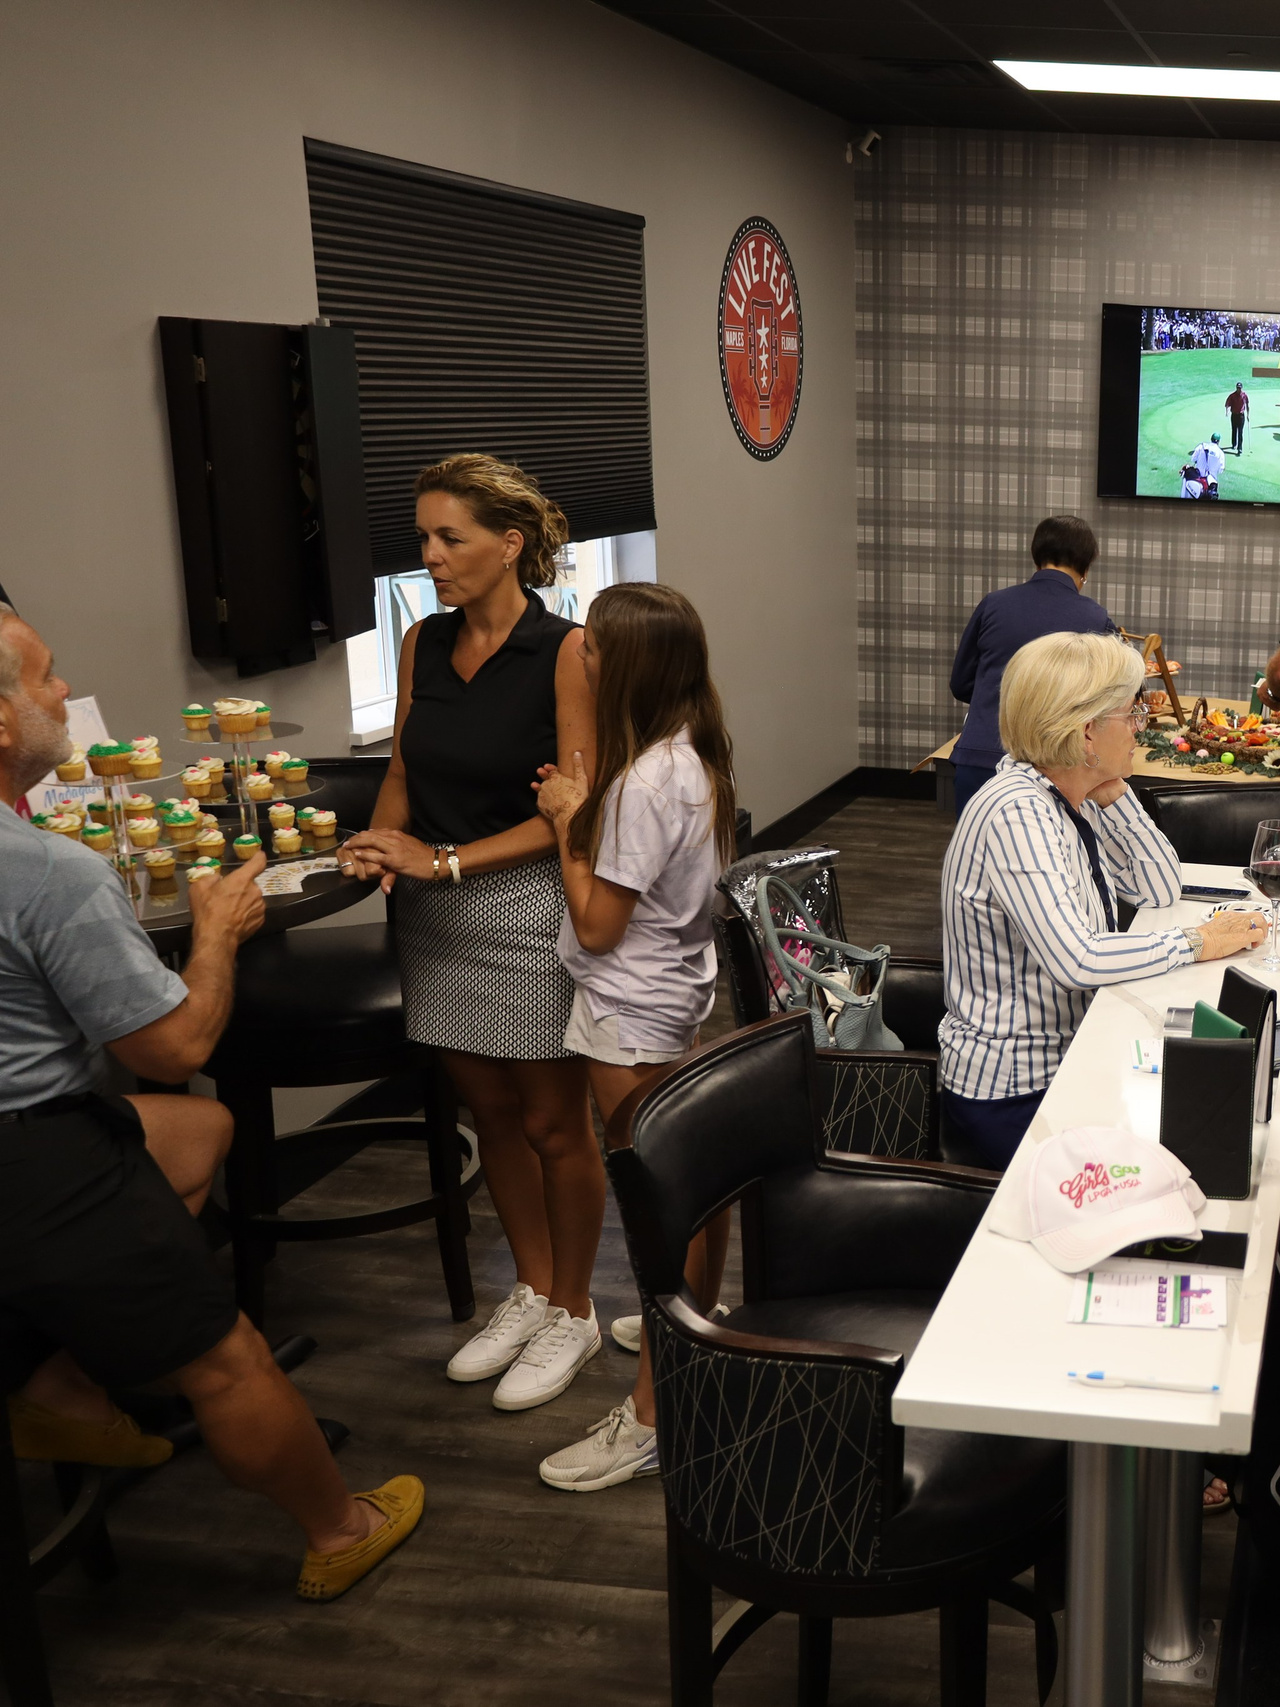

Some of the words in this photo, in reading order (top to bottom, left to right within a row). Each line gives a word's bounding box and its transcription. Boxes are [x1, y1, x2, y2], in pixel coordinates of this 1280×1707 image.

[729, 240, 760, 318] LIVE
[763, 242, 795, 321] FEST
[725, 329, 745, 347] NAPLES
[781, 335, 798, 351] FLORIDA
[1059, 1162, 1110, 1209] Girls
[1087, 1187, 1113, 1203] LPGA
[1120, 1178, 1142, 1190] USGA
